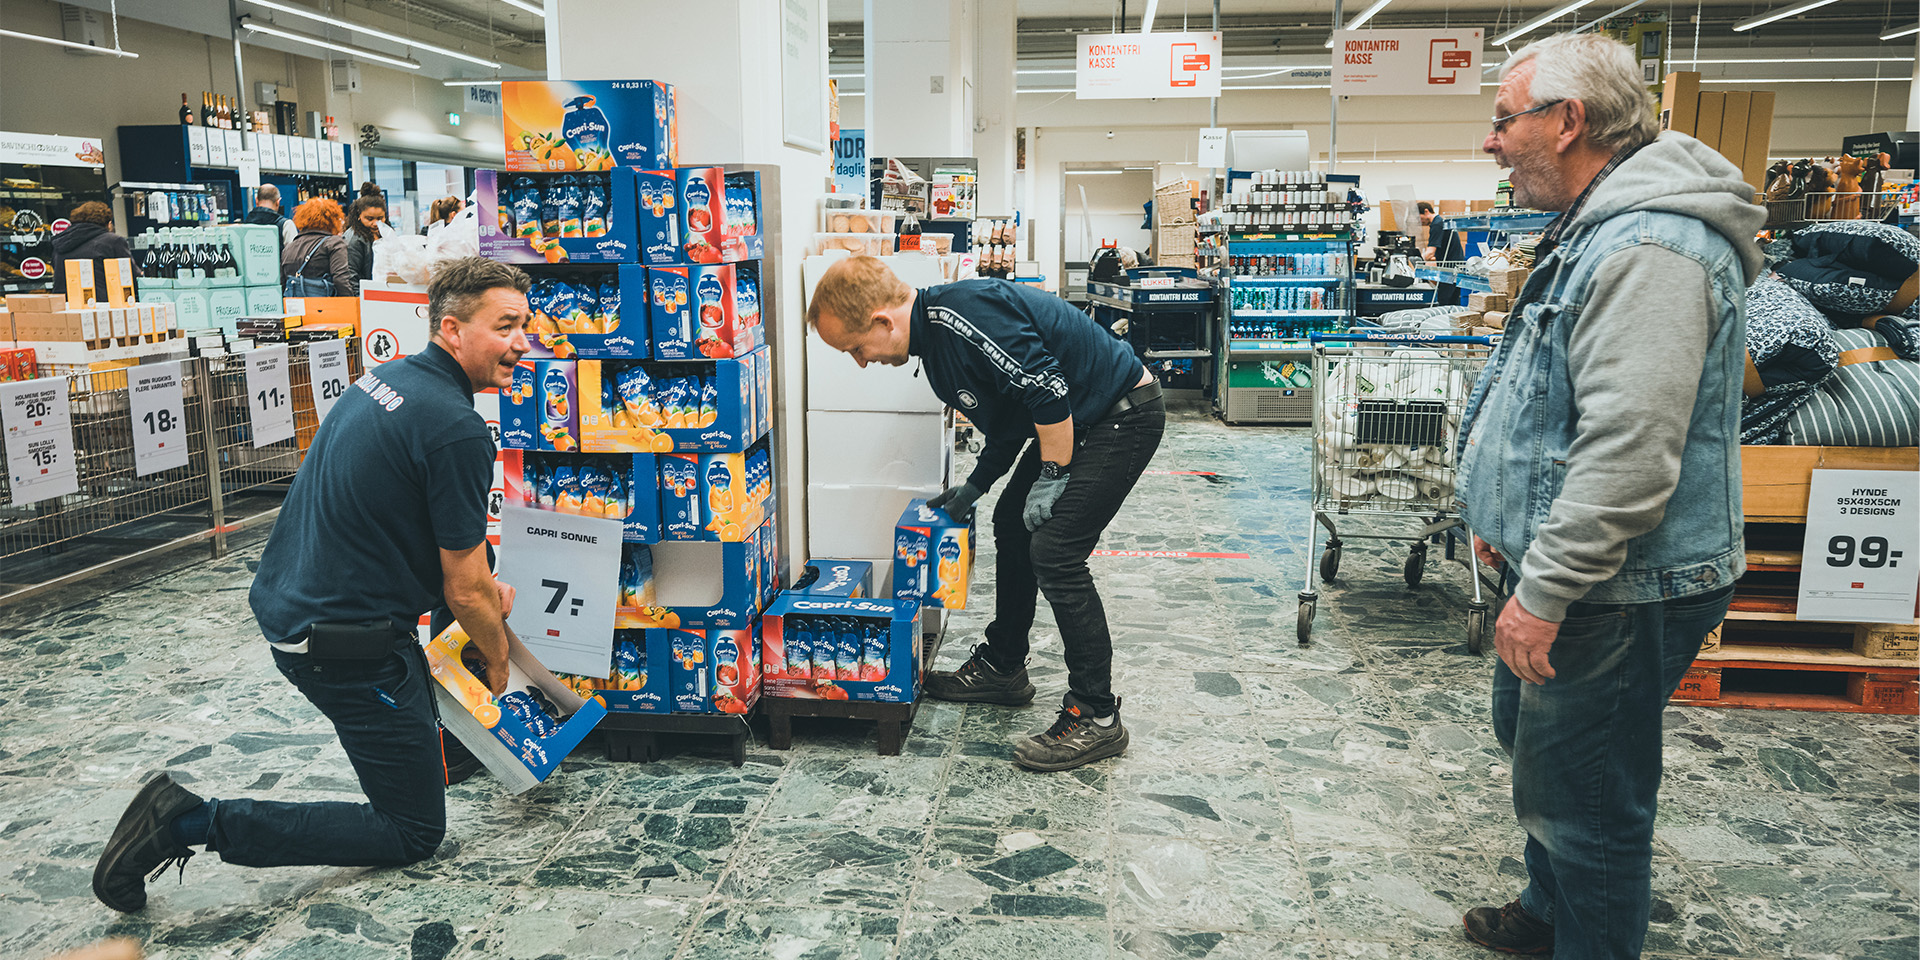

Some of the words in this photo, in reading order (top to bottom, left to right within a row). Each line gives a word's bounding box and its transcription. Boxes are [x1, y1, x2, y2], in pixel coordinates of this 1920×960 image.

[1088, 44, 1140, 56] KONTANTFRI
[1345, 40, 1399, 52] KONTANTFRI
[1088, 58, 1116, 68] KASSE
[1344, 53, 1372, 64] KASSE
[1290, 70, 1323, 78] emballage
[470, 84, 478, 101] PÅ
[566, 122, 606, 138] Capri-Sun
[618, 142, 647, 152] Capri-Sun
[596, 240, 626, 250] Capri-Sun
[647, 244, 675, 253] Capri-Sun
[1406, 293, 1424, 301] KASSE
[544, 292, 574, 314] Capri-Sun
[954, 320, 973, 338] 1000
[604, 336, 634, 346] Capri-Sun
[659, 340, 687, 348] Capri-Sun
[982, 341, 1004, 366] REMA
[151, 381, 176, 390] VARIANTER
[370, 382, 404, 412] 1000
[504, 430, 532, 439] Capri-Sun
[701, 431, 732, 440] Capri-Sun
[1837, 497, 1901, 506] 95X49X5CM
[668, 522, 696, 531] Capri-Sun
[527, 527, 558, 538] CAPRI
[561, 532, 598, 544] SONNE
[897, 588, 924, 598] Capri-Sun
[793, 600, 895, 613] Capri-Sun
[706, 608, 737, 618] Capri-Sun
[874, 685, 902, 694] Capri-Sun
[632, 692, 661, 701] Capri-Sun
[676, 694, 703, 702] Capri-Sun
[505, 695, 531, 719] Capri-Sun
[523, 738, 548, 765] Capri-Sun
